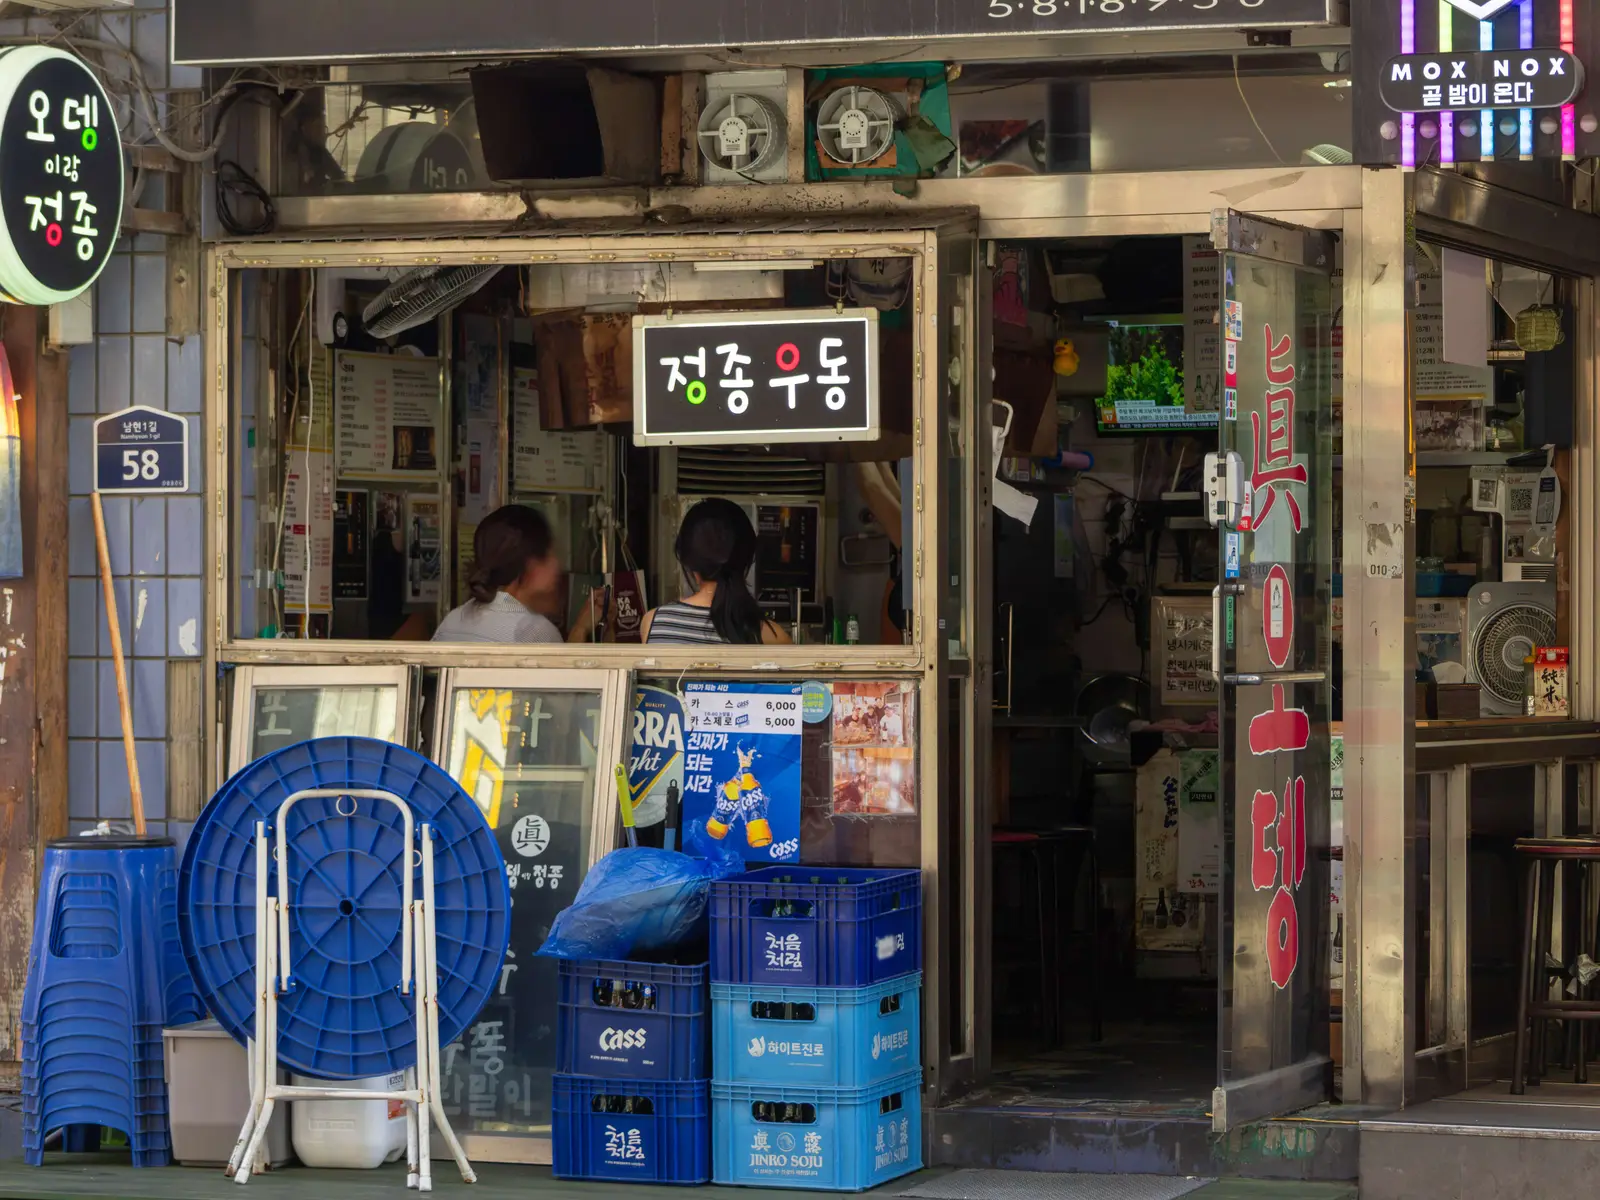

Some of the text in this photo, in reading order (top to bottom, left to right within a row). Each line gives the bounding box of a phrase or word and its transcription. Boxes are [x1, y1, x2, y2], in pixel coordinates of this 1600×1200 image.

[1391, 57, 1565, 81] MOX NOX
[1422, 81, 1533, 107] 곧 밤이 온다
[26, 90, 98, 151] 오뎅
[45, 154, 81, 182] 이랑
[25, 190, 98, 261] 정종
[660, 337, 850, 414] 정종우동
[123, 421, 157, 433] 남현1길
[123, 449, 160, 481] 58
[619, 609, 638, 617] LAN
[766, 701, 796, 712] 6,000
[765, 718, 795, 728] 5,000
[687, 732, 729, 751] 진짜가
[684, 753, 713, 771] 되는
[684, 774, 713, 794] 시간
[516, 817, 546, 851] 眞
[769, 838, 798, 858] Cass
[533, 864, 563, 889] 정종
[765, 931, 802, 951] 처음
[765, 950, 803, 968] 처럼
[599, 1027, 647, 1052] Cass
[768, 1040, 824, 1057] 하이트진로
[881, 1029, 908, 1051] 하이트진로
[604, 1124, 641, 1145] 처음
[605, 1143, 645, 1160] 처럼
[749, 1154, 823, 1168] JINRO SOJU
